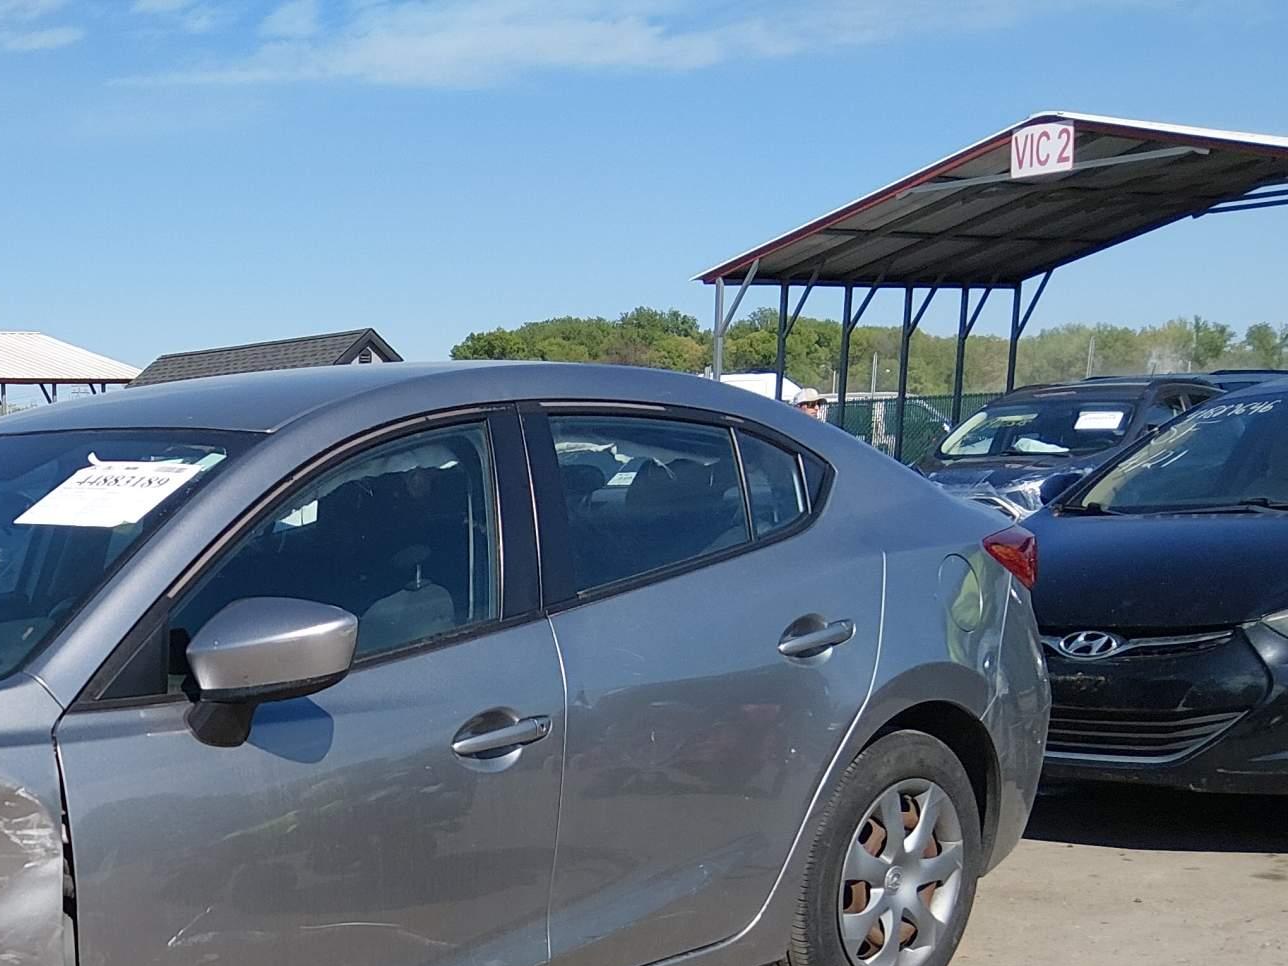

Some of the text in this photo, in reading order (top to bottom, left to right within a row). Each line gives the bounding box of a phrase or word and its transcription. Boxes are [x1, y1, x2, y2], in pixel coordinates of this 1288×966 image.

[1015, 128, 1071, 170] VIC 2
[76, 475, 170, 488] 44883189
